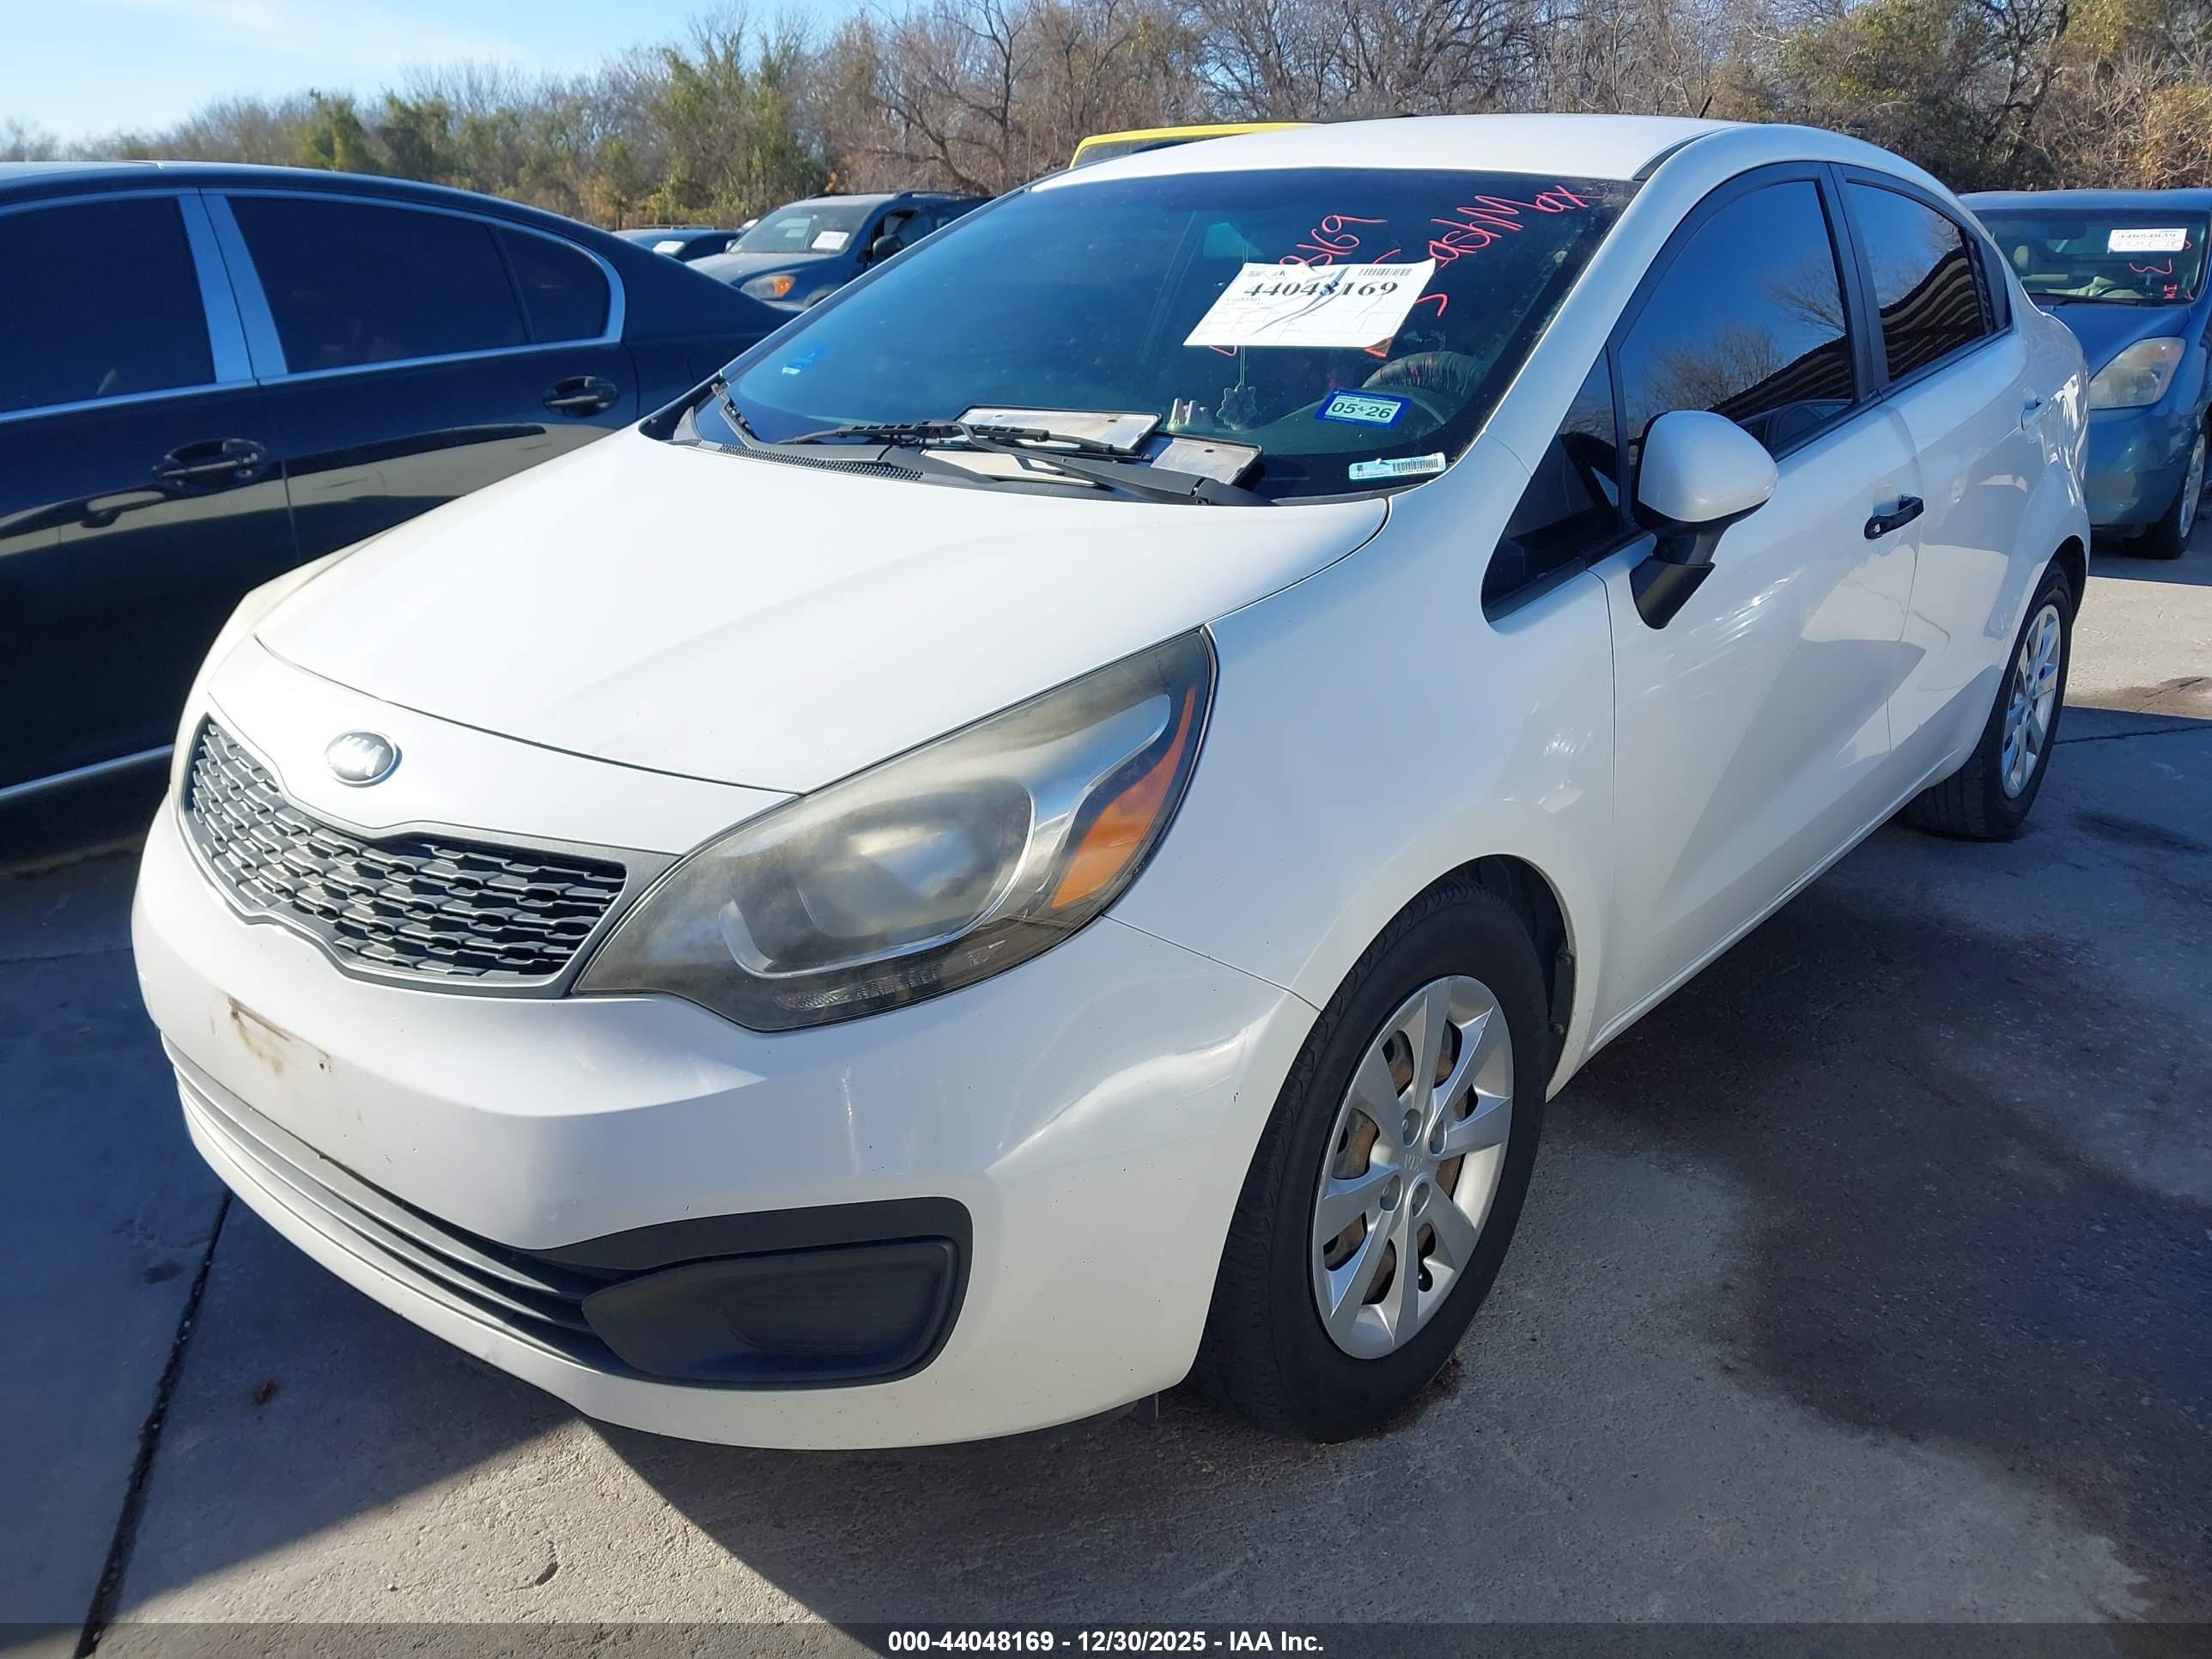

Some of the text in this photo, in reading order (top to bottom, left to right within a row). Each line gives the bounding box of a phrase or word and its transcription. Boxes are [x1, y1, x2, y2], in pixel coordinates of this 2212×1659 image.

[1428, 185, 1603, 268] ashMax
[1243, 280, 1399, 297] 44048169
[1331, 401, 1358, 414] 05
[1364, 405, 1393, 419] 26
